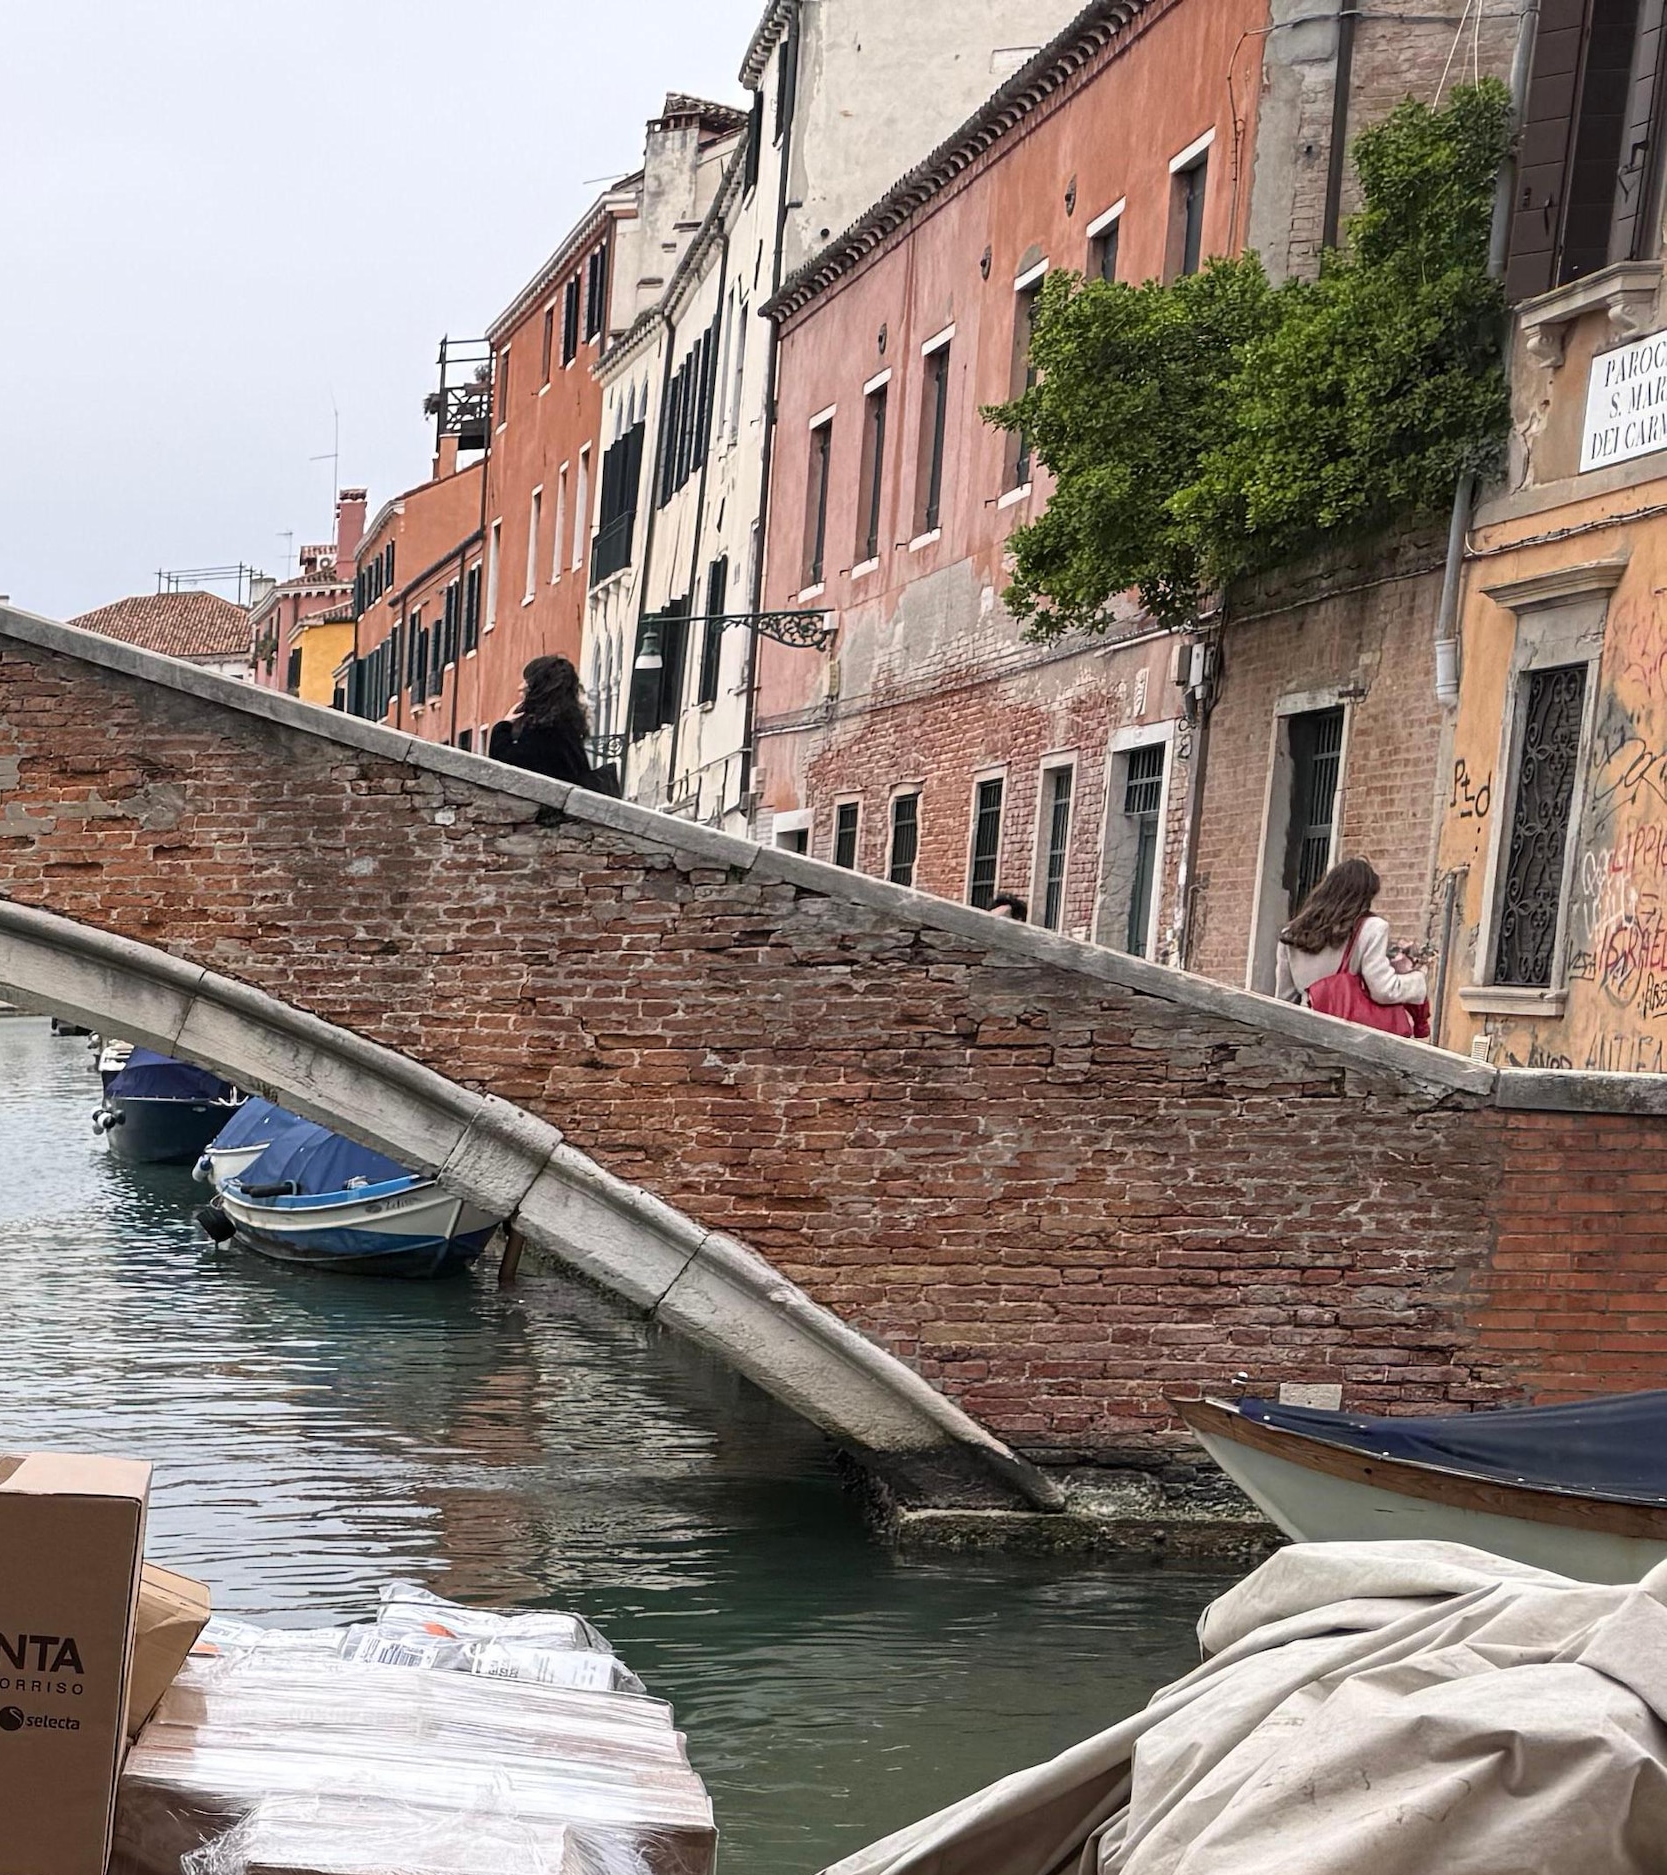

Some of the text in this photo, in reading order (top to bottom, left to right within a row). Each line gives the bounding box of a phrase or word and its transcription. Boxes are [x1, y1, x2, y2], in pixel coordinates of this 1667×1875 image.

[1609, 392, 1622, 418] S.
[1591, 427, 1620, 460] DEI
[26, 1714, 81, 1731] selecta
